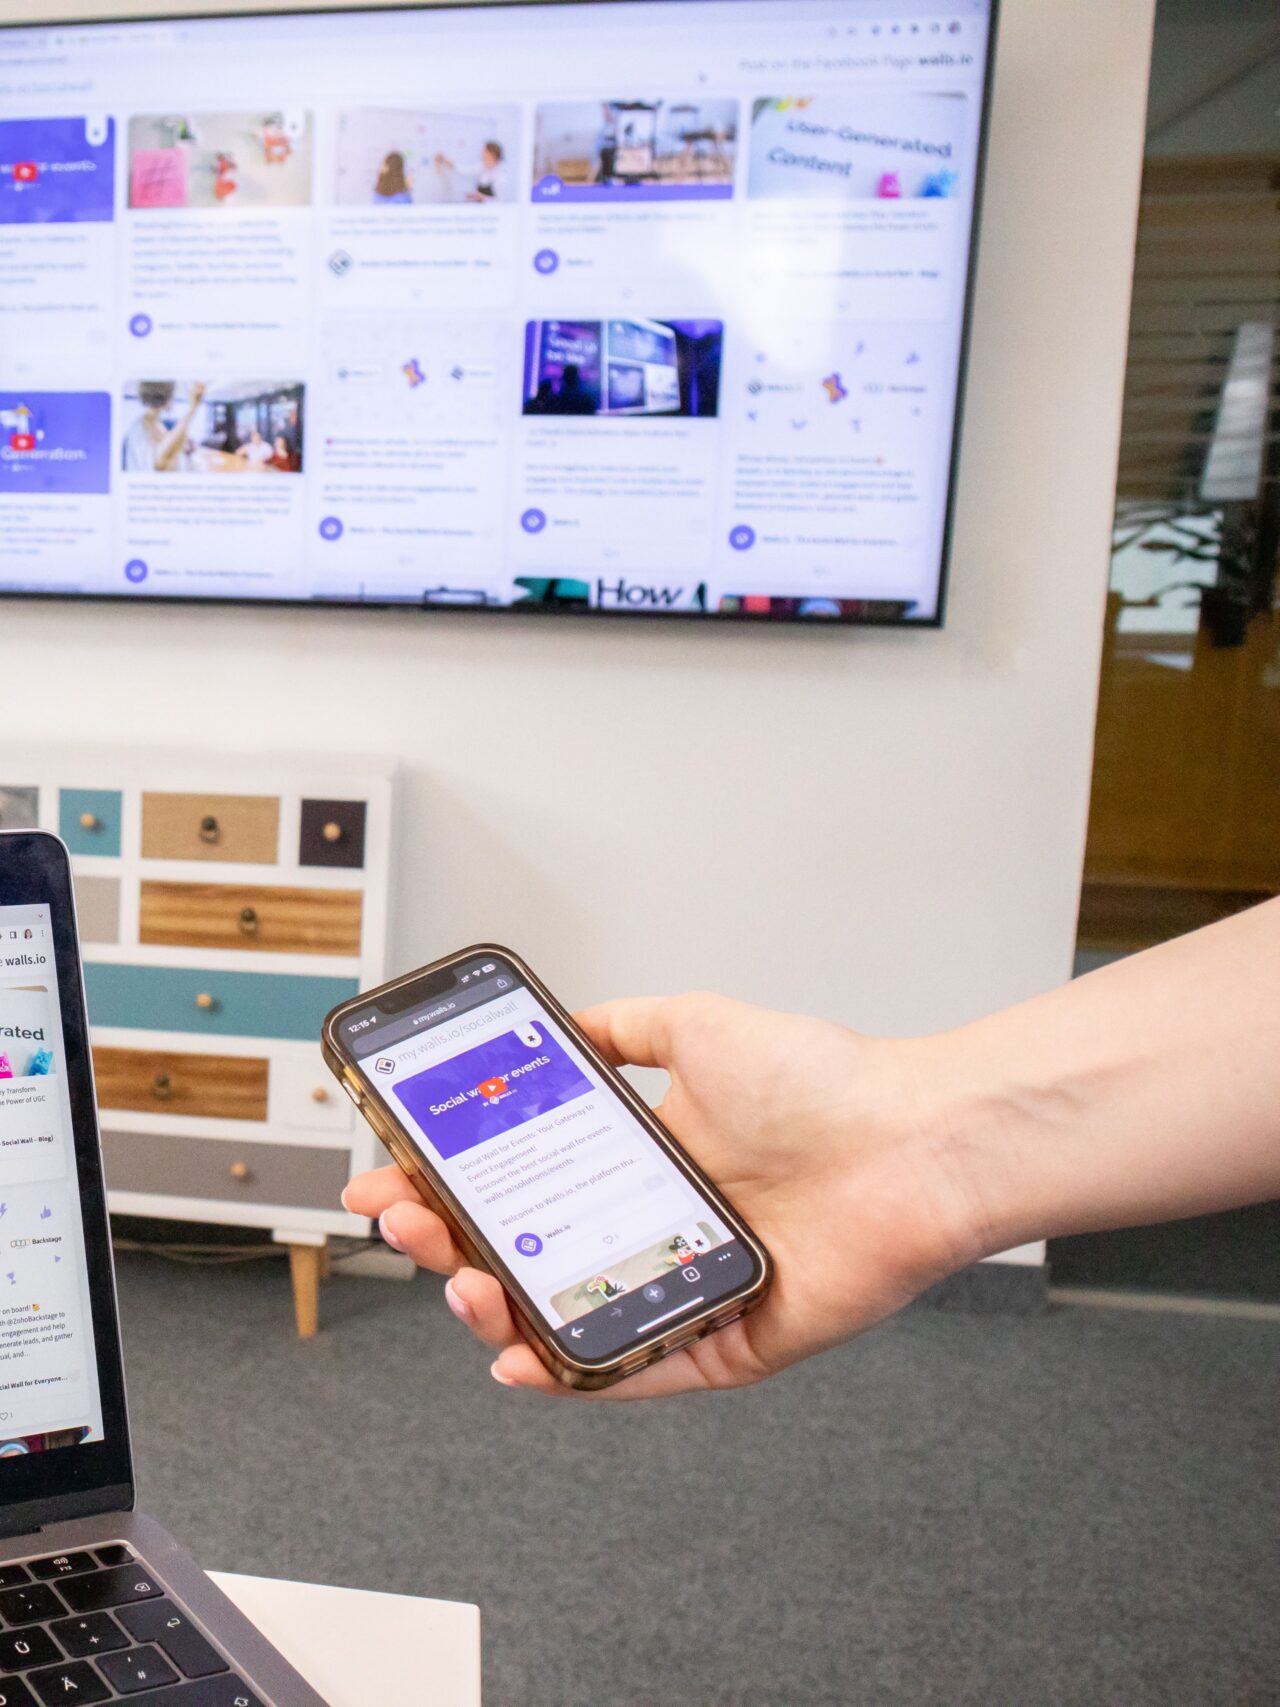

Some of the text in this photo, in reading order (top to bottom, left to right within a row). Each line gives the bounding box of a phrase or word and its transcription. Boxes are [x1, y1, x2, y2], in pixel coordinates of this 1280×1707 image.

[787, 119, 952, 158] User-Generated
[768, 147, 852, 176] Content
[598, 577, 682, 606] How
[5, 953, 47, 966] walls.io
[418, 1002, 456, 1024] my.walls.io
[348, 1020, 370, 1033] 12:15
[398, 1000, 519, 1062] my.walls.io/socialwall
[429, 1092, 468, 1115] Social
[511, 1055, 550, 1078] events
[2, 1138, 20, 1146] Social
[38, 1135, 54, 1143] Blog)
[458, 1157, 482, 1172] Social
[482, 1149, 499, 1162] Wall
[500, 1142, 510, 1154] for
[537, 1123, 553, 1136] Your
[554, 1109, 586, 1126] Gateway
[586, 1104, 594, 1112] to
[466, 1169, 489, 1182] Event
[545, 1224, 571, 1240] Walls.io
[32, 1236, 62, 1245] Backstage
[14, 1641, 30, 1654] Ü
[61, 1676, 78, 1690] Ä
